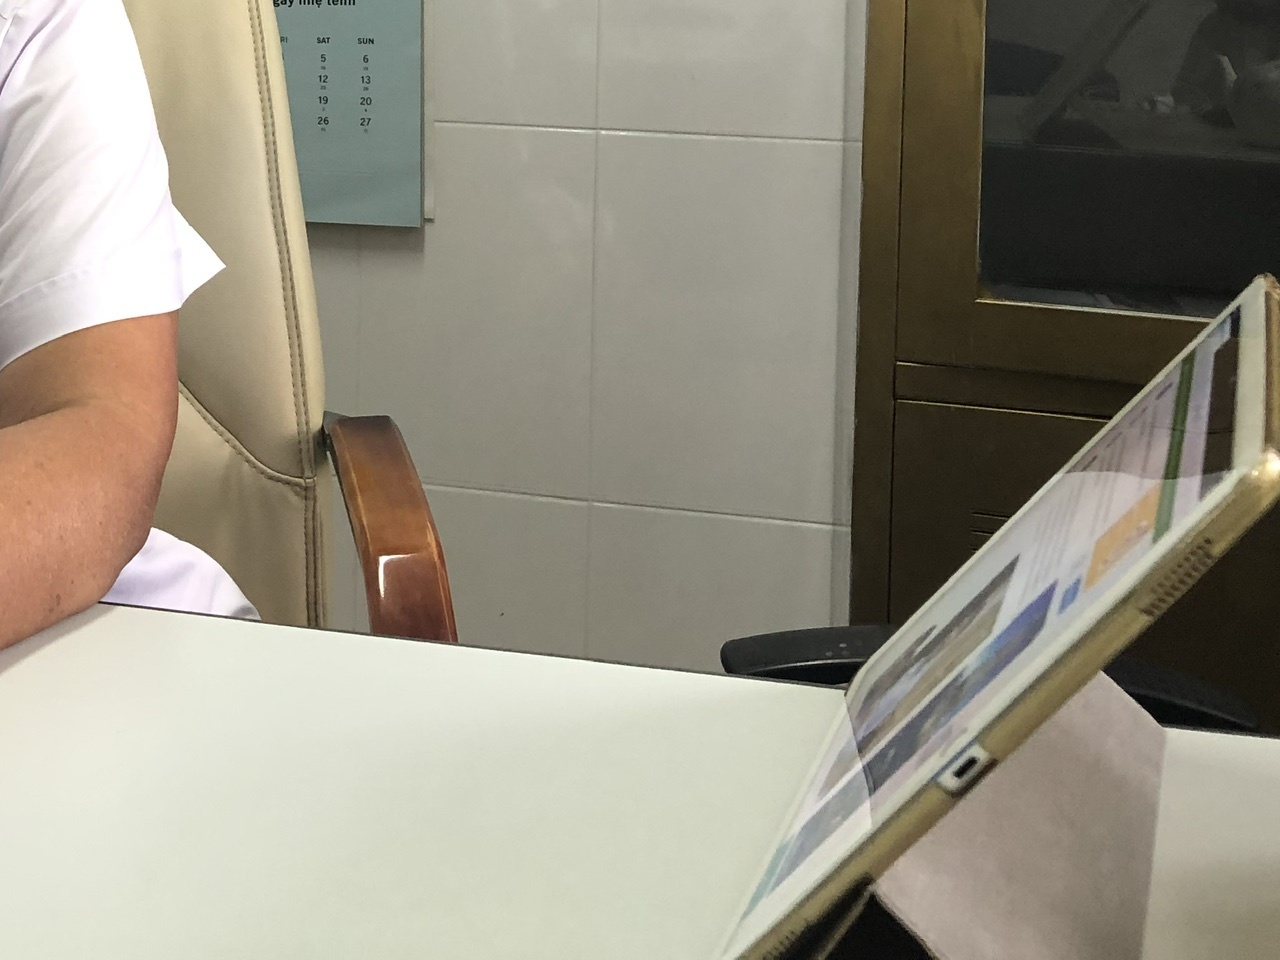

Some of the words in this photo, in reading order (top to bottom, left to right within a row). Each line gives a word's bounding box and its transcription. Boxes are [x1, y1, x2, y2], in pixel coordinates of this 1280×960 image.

[316, 36, 331, 44] SAT
[357, 37, 375, 45] SUN
[320, 53, 327, 63] 5
[362, 54, 369, 64] 6
[318, 74, 328, 83] 12
[360, 75, 371, 84] 13
[318, 95, 329, 105] 19
[359, 96, 372, 105] 20
[317, 116, 330, 125] 26
[359, 117, 372, 126] 27
